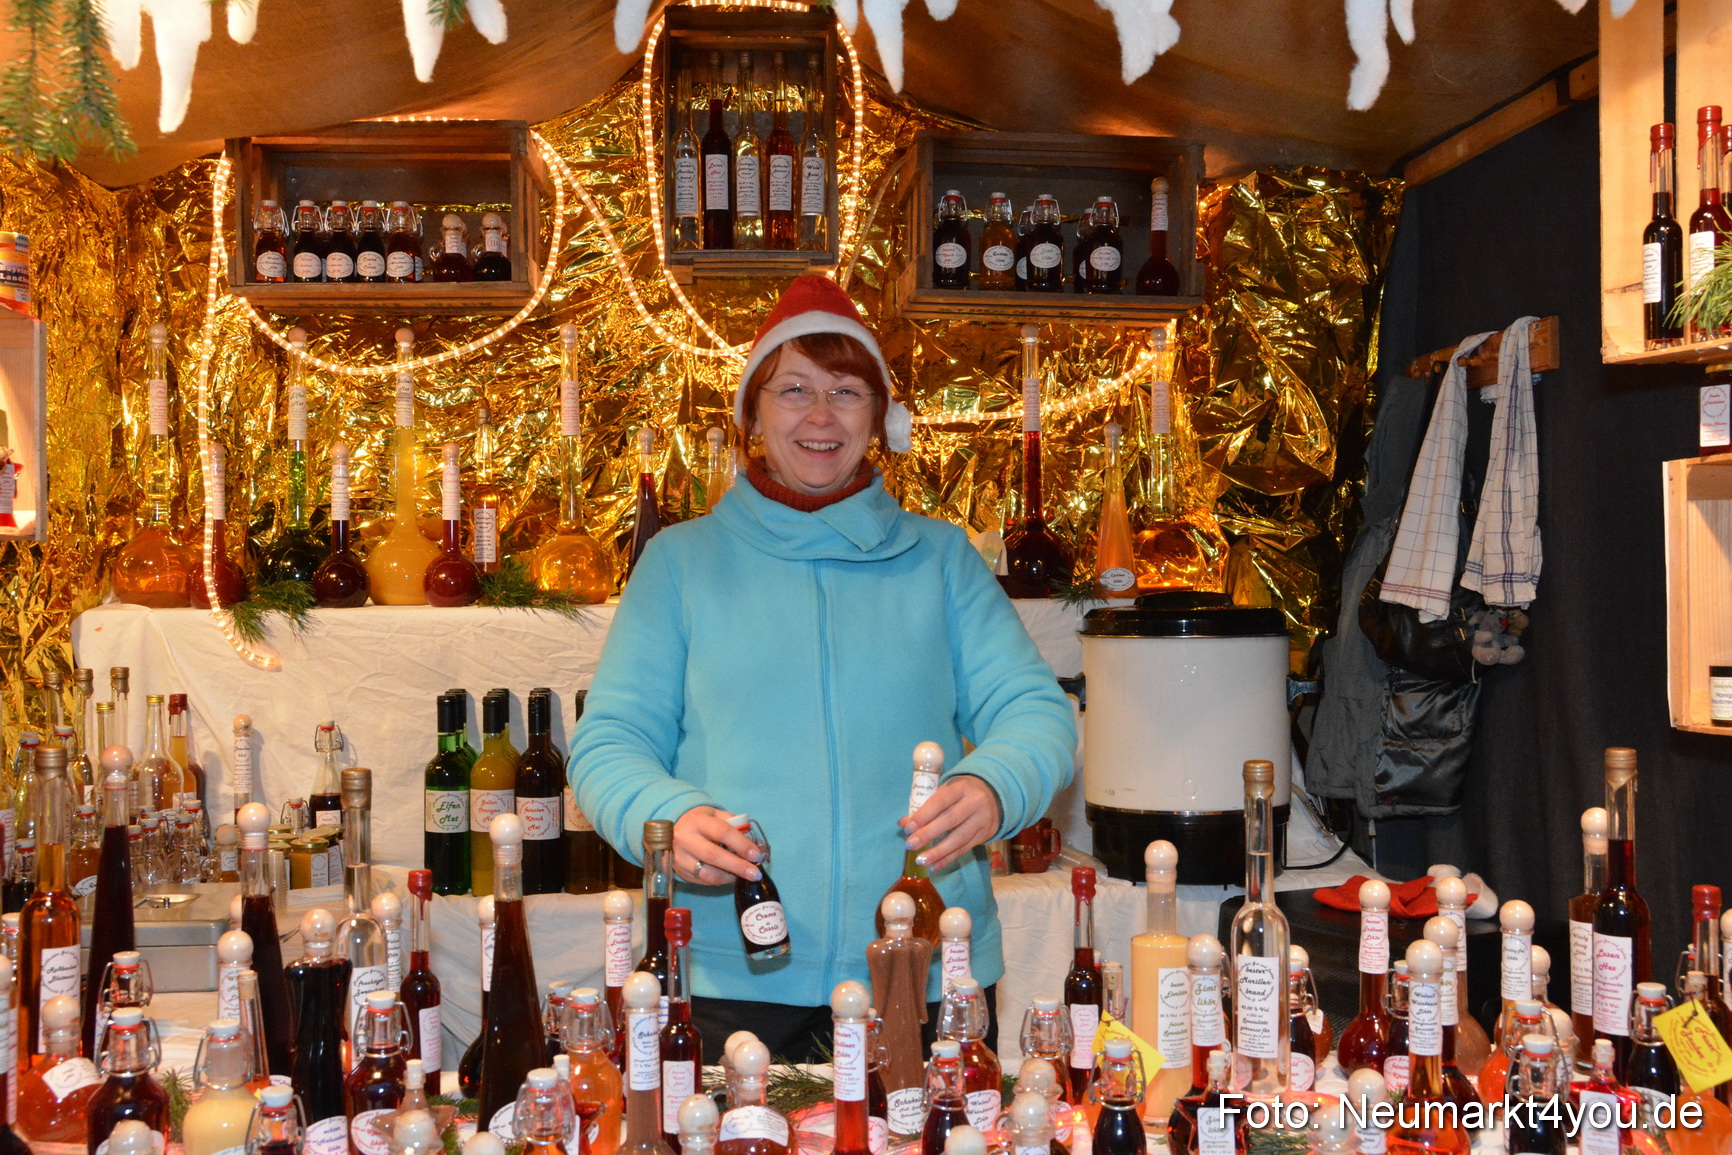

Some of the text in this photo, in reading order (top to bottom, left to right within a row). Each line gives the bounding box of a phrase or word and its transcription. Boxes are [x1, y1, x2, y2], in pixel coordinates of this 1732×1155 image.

[436, 801, 461, 813] Elfen
[439, 814, 459, 825] Met
[756, 912, 777, 921] Creme
[1245, 966, 1266, 975] bester
[1195, 983, 1217, 996] Zimt
[1245, 987, 1267, 996] brand
[1197, 998, 1217, 1006] likör
